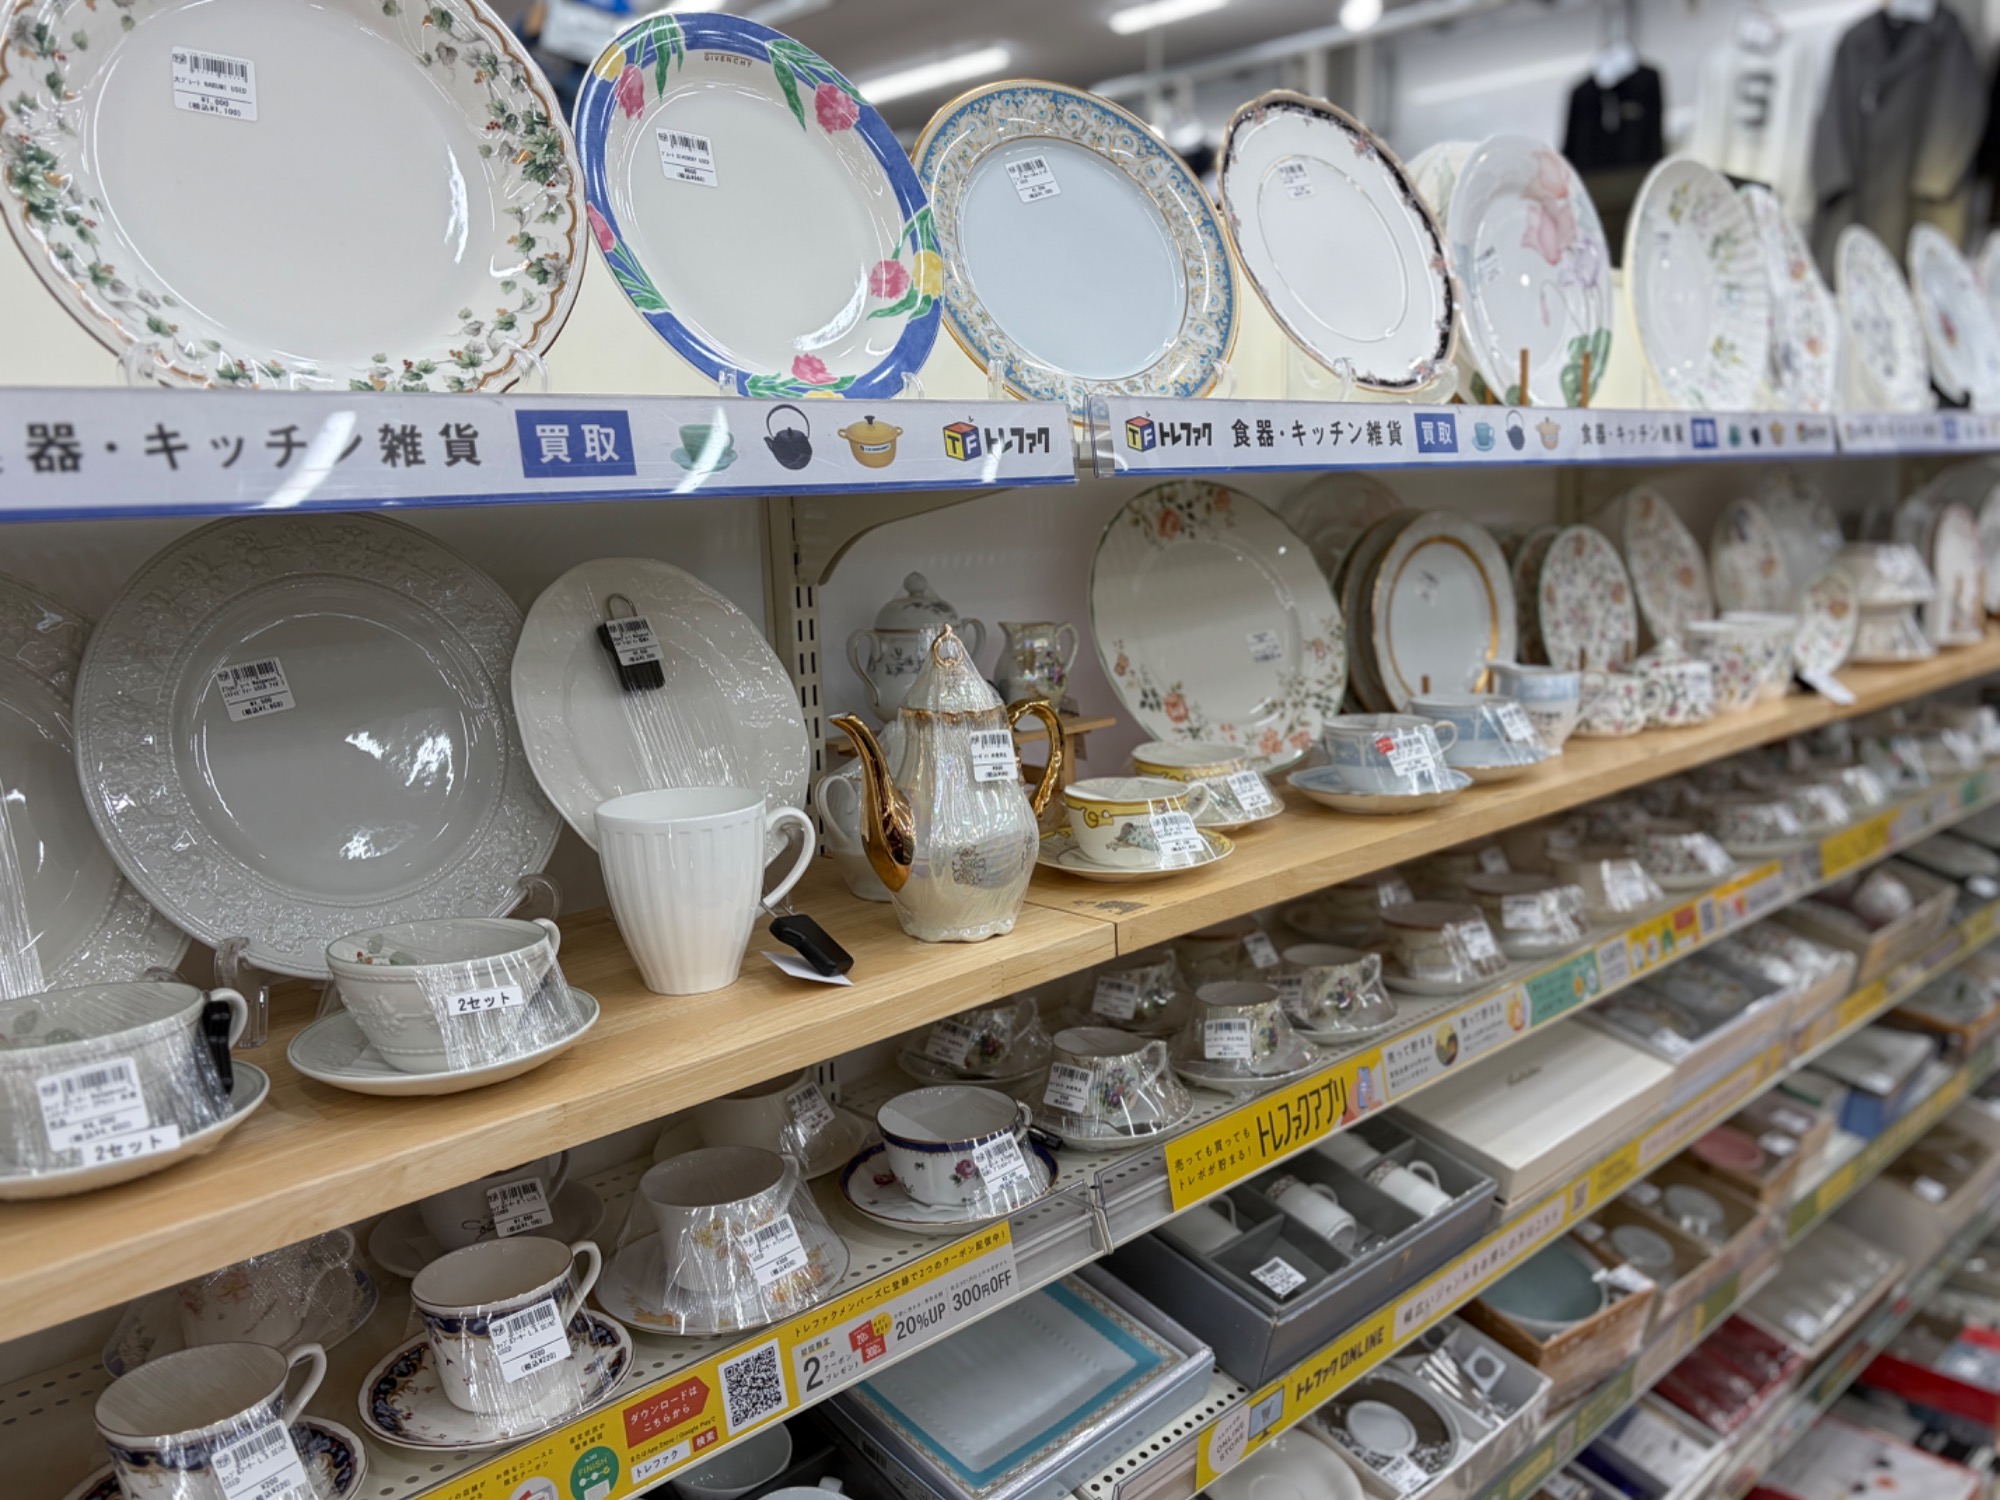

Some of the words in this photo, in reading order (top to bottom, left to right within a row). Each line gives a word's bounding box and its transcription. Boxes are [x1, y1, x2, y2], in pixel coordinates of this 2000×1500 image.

[703, 54, 753, 68] GIVENCHY
[535, 423, 621, 464] 買取
[984, 426, 1050, 454] トレファク
[1158, 422, 1212, 447] トレファク
[1231, 418, 1403, 448] 食器・キッチン雑貨
[1421, 421, 1453, 445] 買取
[0, 422, 482, 474] 器・キッチ雑貨
[457, 991, 510, 1012] 2セット
[1256, 1076, 1348, 1157] トレファクアプリ
[94, 1134, 162, 1161] 2セット
[1174, 1128, 1250, 1173] 売っても買っても
[951, 1269, 1012, 1312] 300円OFF
[895, 1302, 946, 1341] 20%UP
[529, 1347, 546, 1359] ¥200
[822, 1350, 836, 1361] つの
[824, 1354, 852, 1372] クーポン
[1296, 1357, 1338, 1403] トレファク
[1339, 1325, 1385, 1371] ONLINE
[803, 1356, 824, 1392] 2
[826, 1361, 858, 1382] プレゼント
[631, 1385, 698, 1425] ダウンロードは
[643, 1403, 690, 1432] こちらから
[659, 1437, 675, 1450] Store
[680, 1425, 699, 1439] Google
[695, 1430, 716, 1448] 検索
[1216, 1421, 1245, 1454] ONLINE
[1219, 1432, 1245, 1462] STORE
[577, 1456, 608, 1477] FINISH
[636, 1449, 679, 1478] トレファク
[261, 1476, 279, 1490] ¥200
